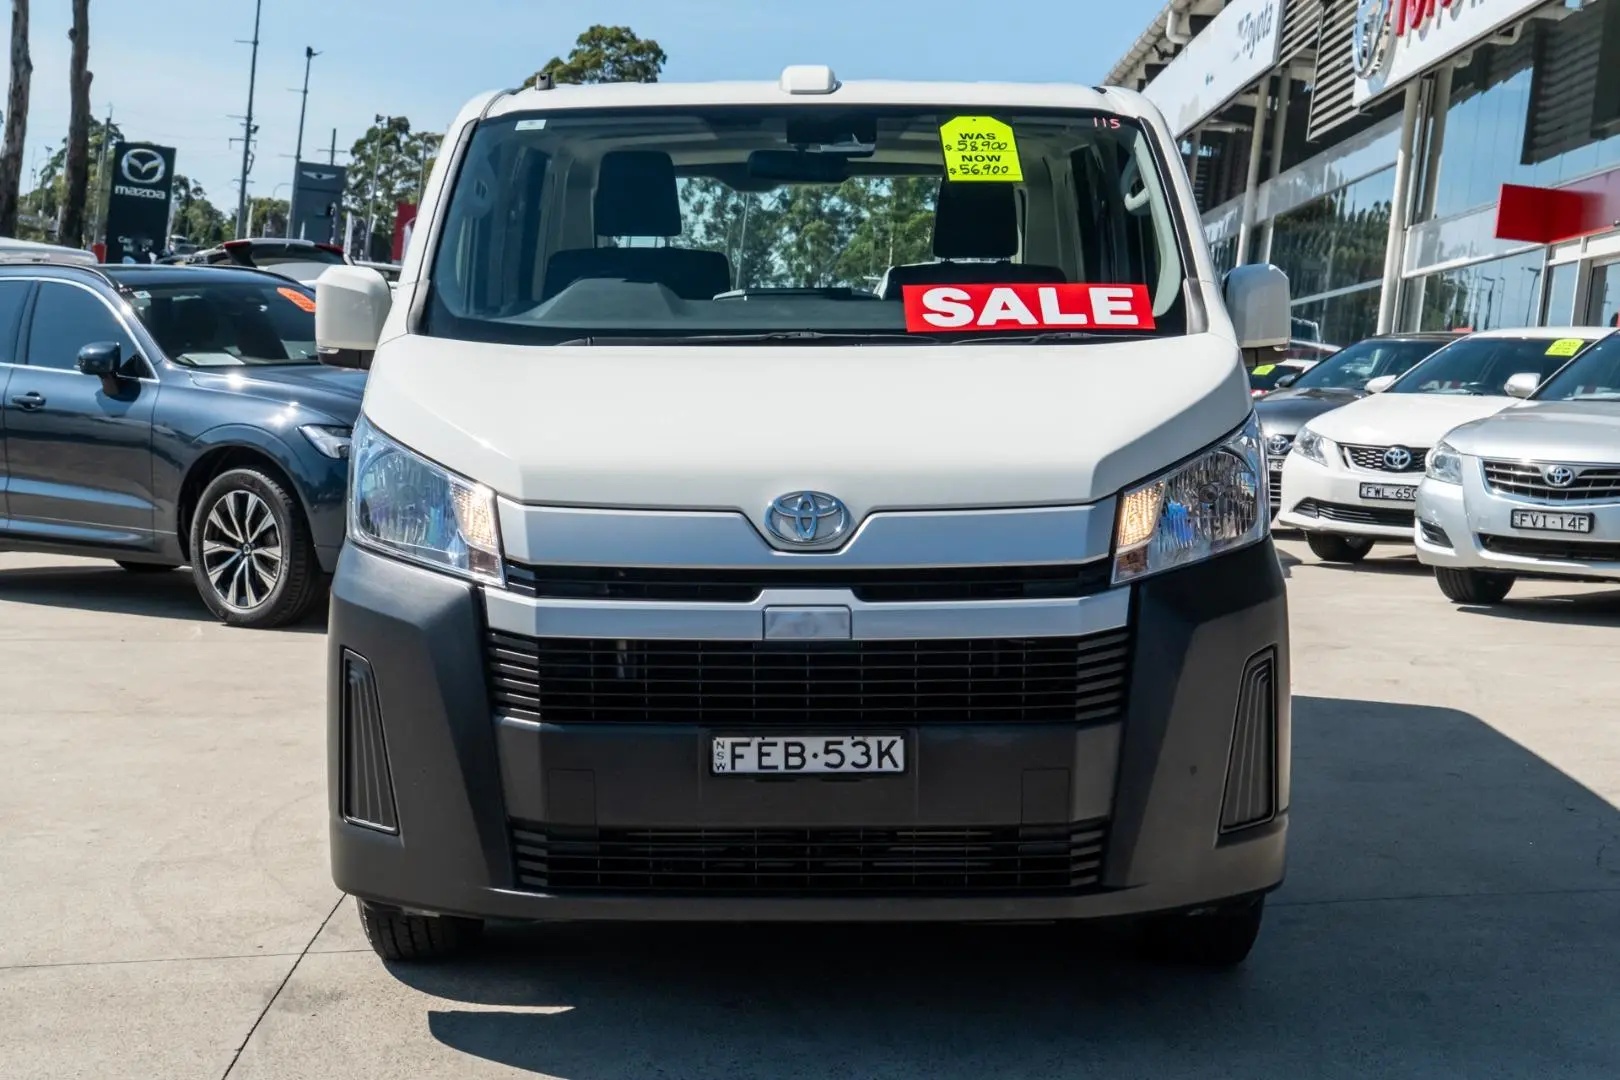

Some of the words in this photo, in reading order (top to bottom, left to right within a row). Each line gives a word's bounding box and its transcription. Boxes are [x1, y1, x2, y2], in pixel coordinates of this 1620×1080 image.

[1093, 117, 1121, 129] 115
[114, 185, 166, 199] mazda
[922, 287, 1139, 327] SALE
